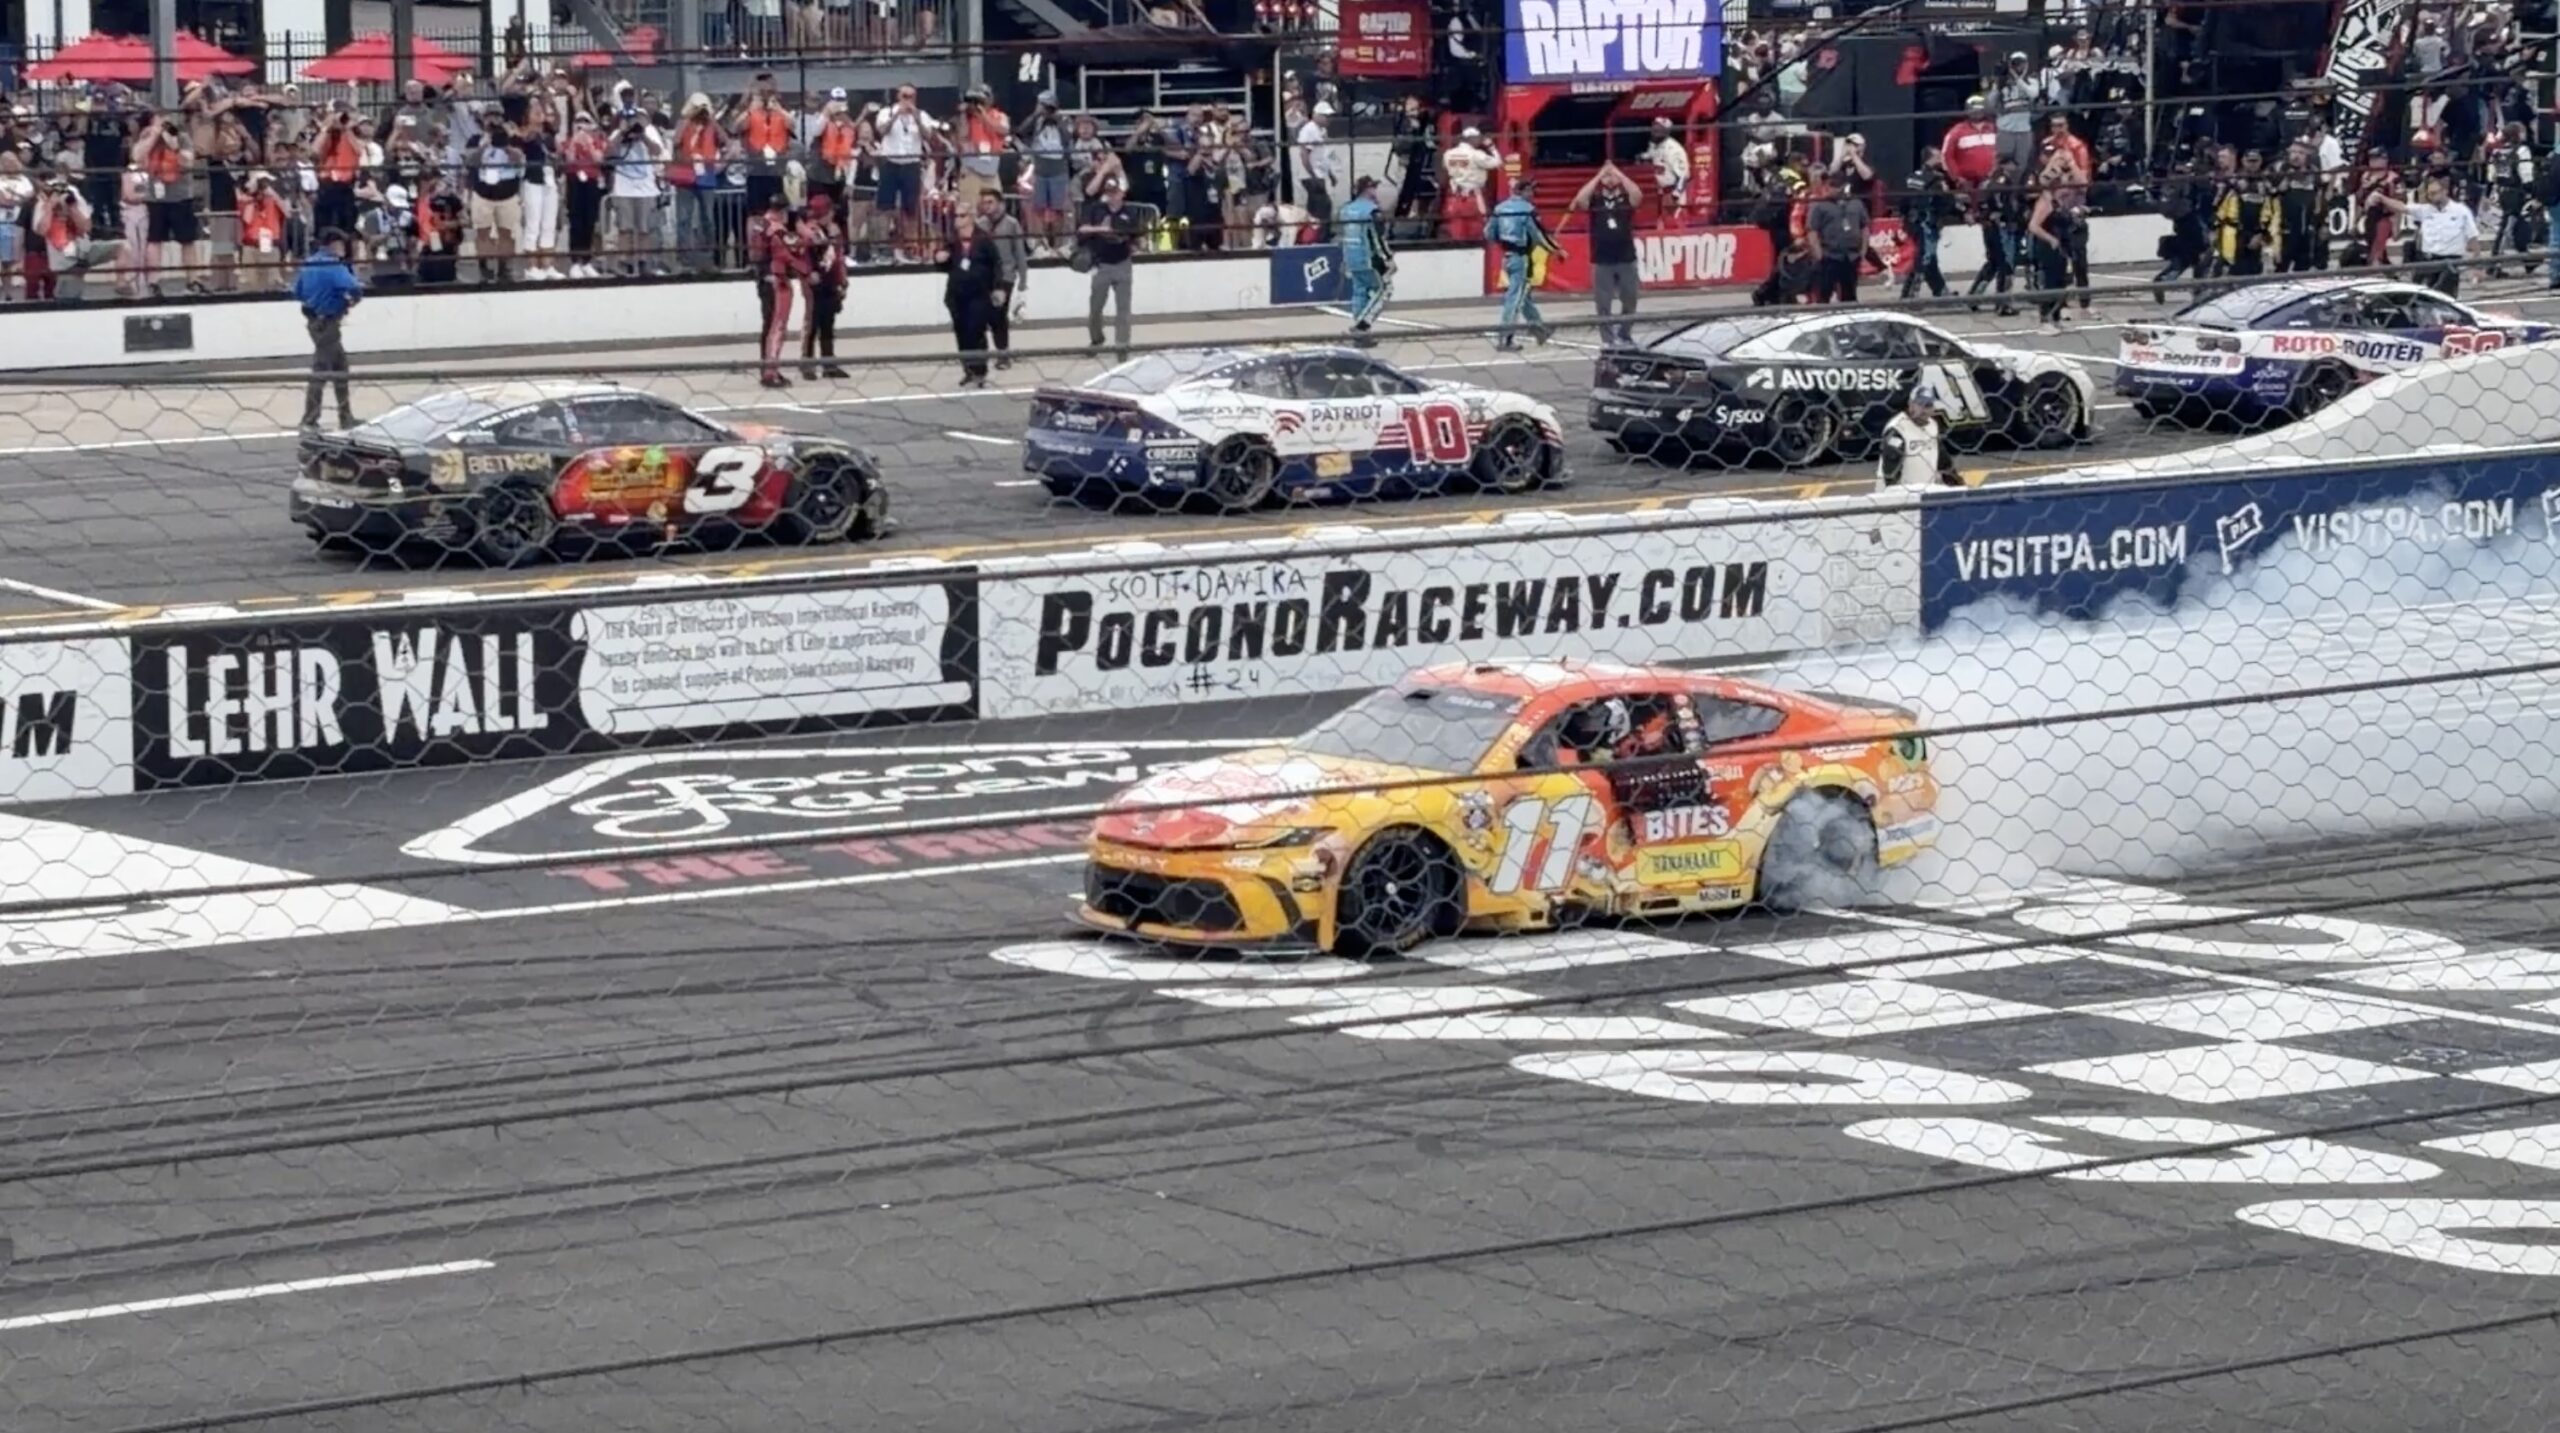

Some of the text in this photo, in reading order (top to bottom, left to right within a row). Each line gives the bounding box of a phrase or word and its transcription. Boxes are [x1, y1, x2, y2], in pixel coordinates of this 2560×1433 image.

[1520, 0, 1706, 75] RAPTOR
[1017, 52, 1041, 82] 24
[1637, 233, 1735, 283] RAPTOR
[2272, 335, 2424, 362] ROTO-ROOTER
[1780, 368, 1903, 391] AUTODESK
[1311, 404, 1383, 422] PATRIOT
[1399, 400, 1472, 466] 10
[683, 446, 766, 514] 3
[2293, 498, 2514, 554] VISITPA.COM
[1954, 525, 2187, 581] VISITPA.COM
[167, 625, 549, 759] LEHR WALL
[0, 689, 77, 759] M
[810, 820, 1092, 866] TRIC
[1491, 795, 1592, 895] 11
[1644, 805, 1730, 842] BITES
[545, 847, 812, 891] THE
